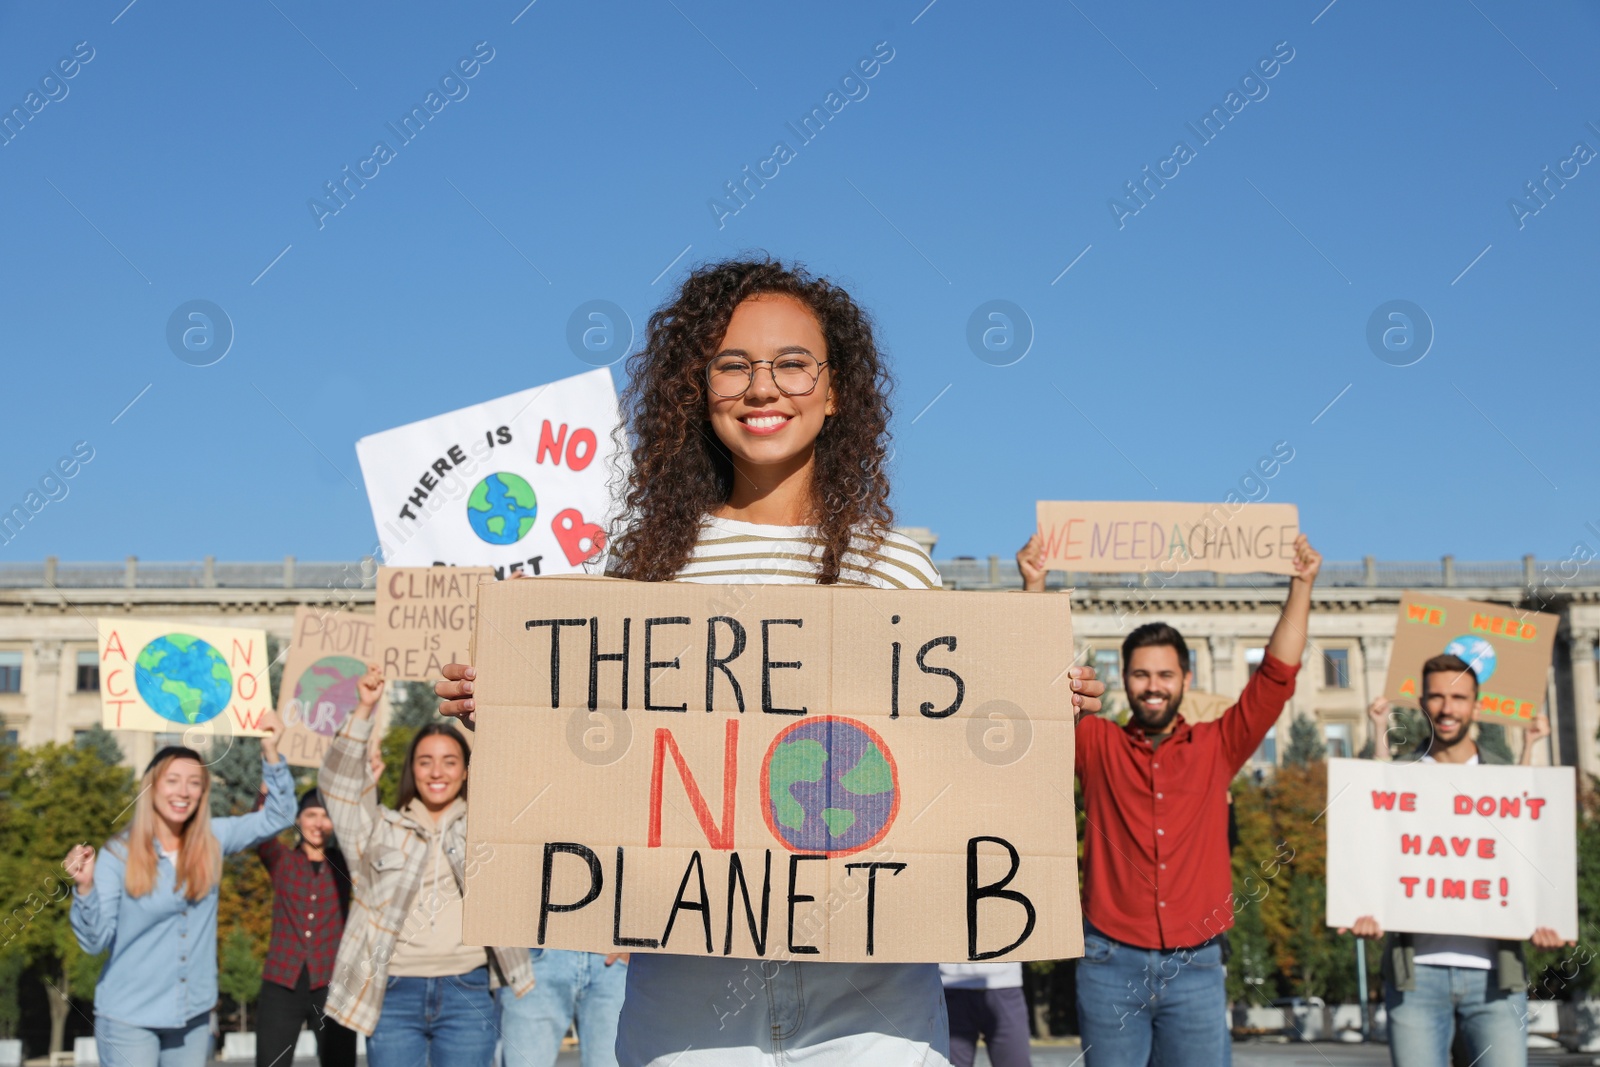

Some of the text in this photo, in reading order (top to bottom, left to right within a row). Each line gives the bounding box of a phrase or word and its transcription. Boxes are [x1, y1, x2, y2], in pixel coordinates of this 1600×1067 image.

[536, 419, 598, 472] NO
[399, 425, 513, 522] THERE IS
[551, 508, 607, 567] B
[1037, 518, 1297, 561] WE NEED A CHANGE
[298, 614, 375, 658] PROTE
[1406, 603, 1537, 640] WE NEED
[525, 615, 807, 716] THERE
[283, 697, 337, 731] OUR
[1399, 677, 1535, 719] A NGE
[1371, 790, 1546, 820] WE DON'T
[1400, 834, 1496, 859] HAVE
[537, 836, 1037, 961] PLANET B
[1399, 877, 1509, 907] TIME!
